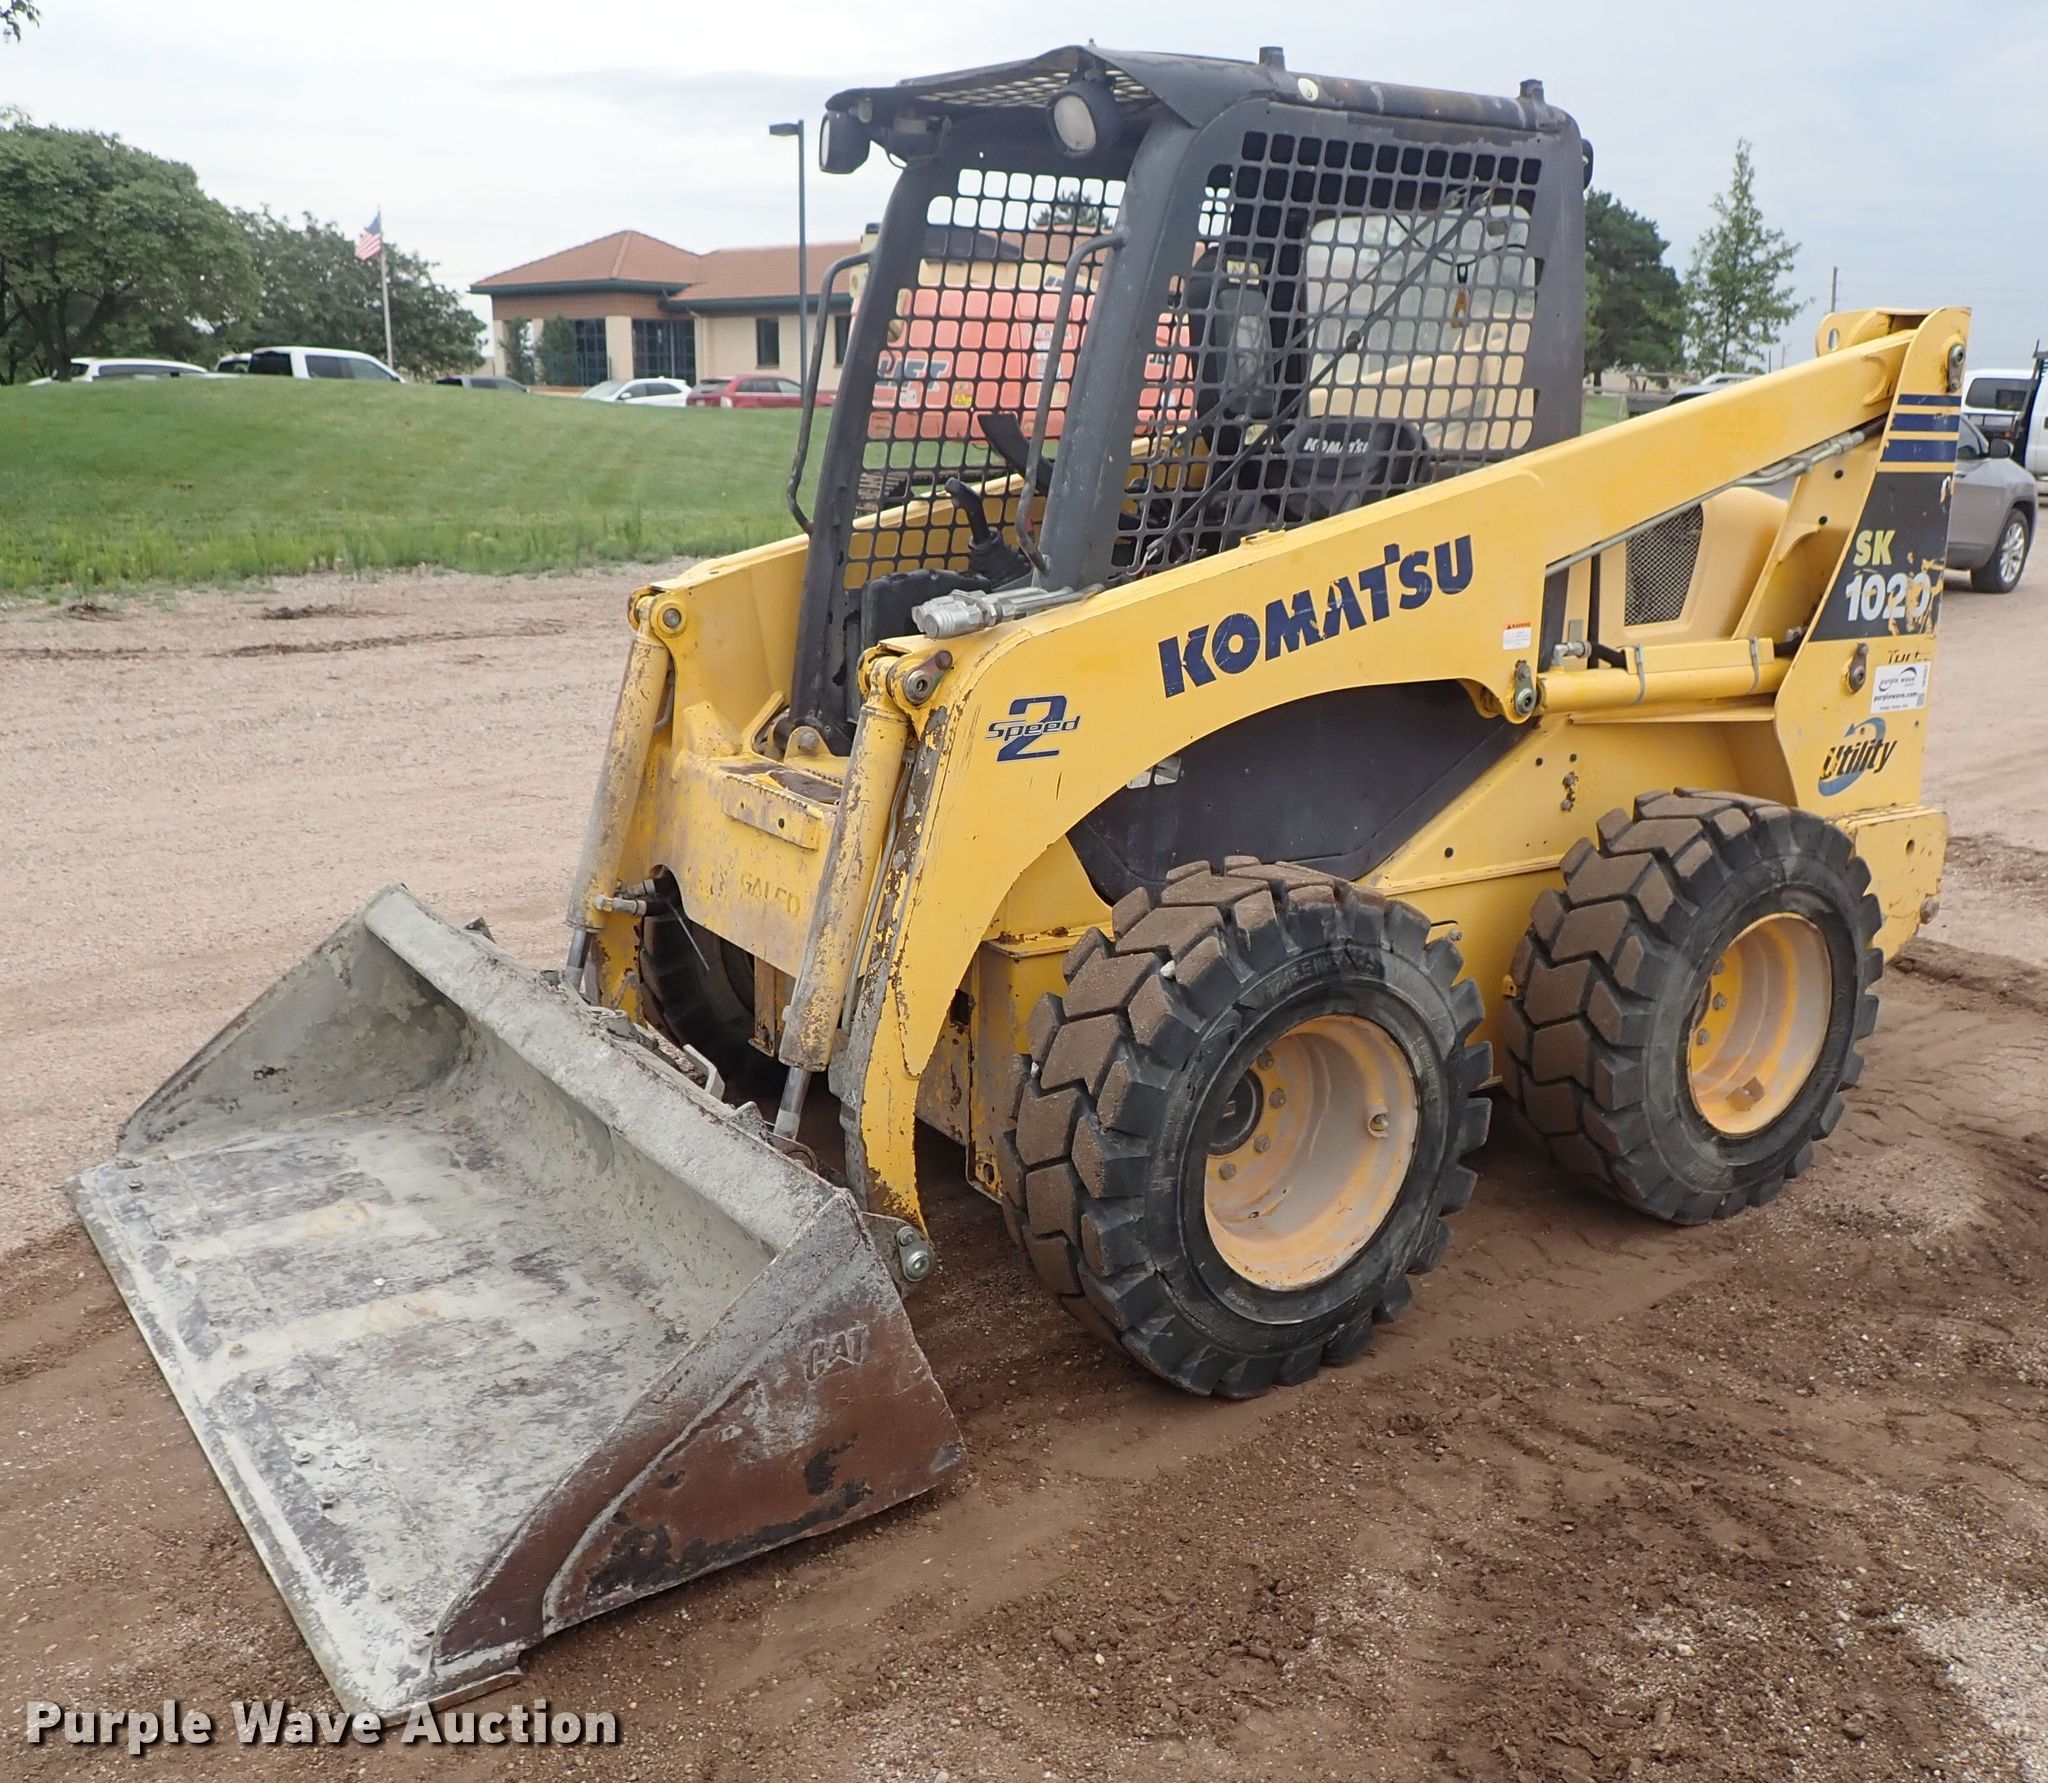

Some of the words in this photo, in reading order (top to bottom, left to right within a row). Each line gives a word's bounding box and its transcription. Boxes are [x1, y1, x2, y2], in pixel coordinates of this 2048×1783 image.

[1853, 529, 1896, 566] SK
[1157, 534, 1474, 699] KOMATSU
[985, 715, 1080, 741] Speed
[996, 695, 1067, 762] 2
[1819, 739, 1898, 780] Utility
